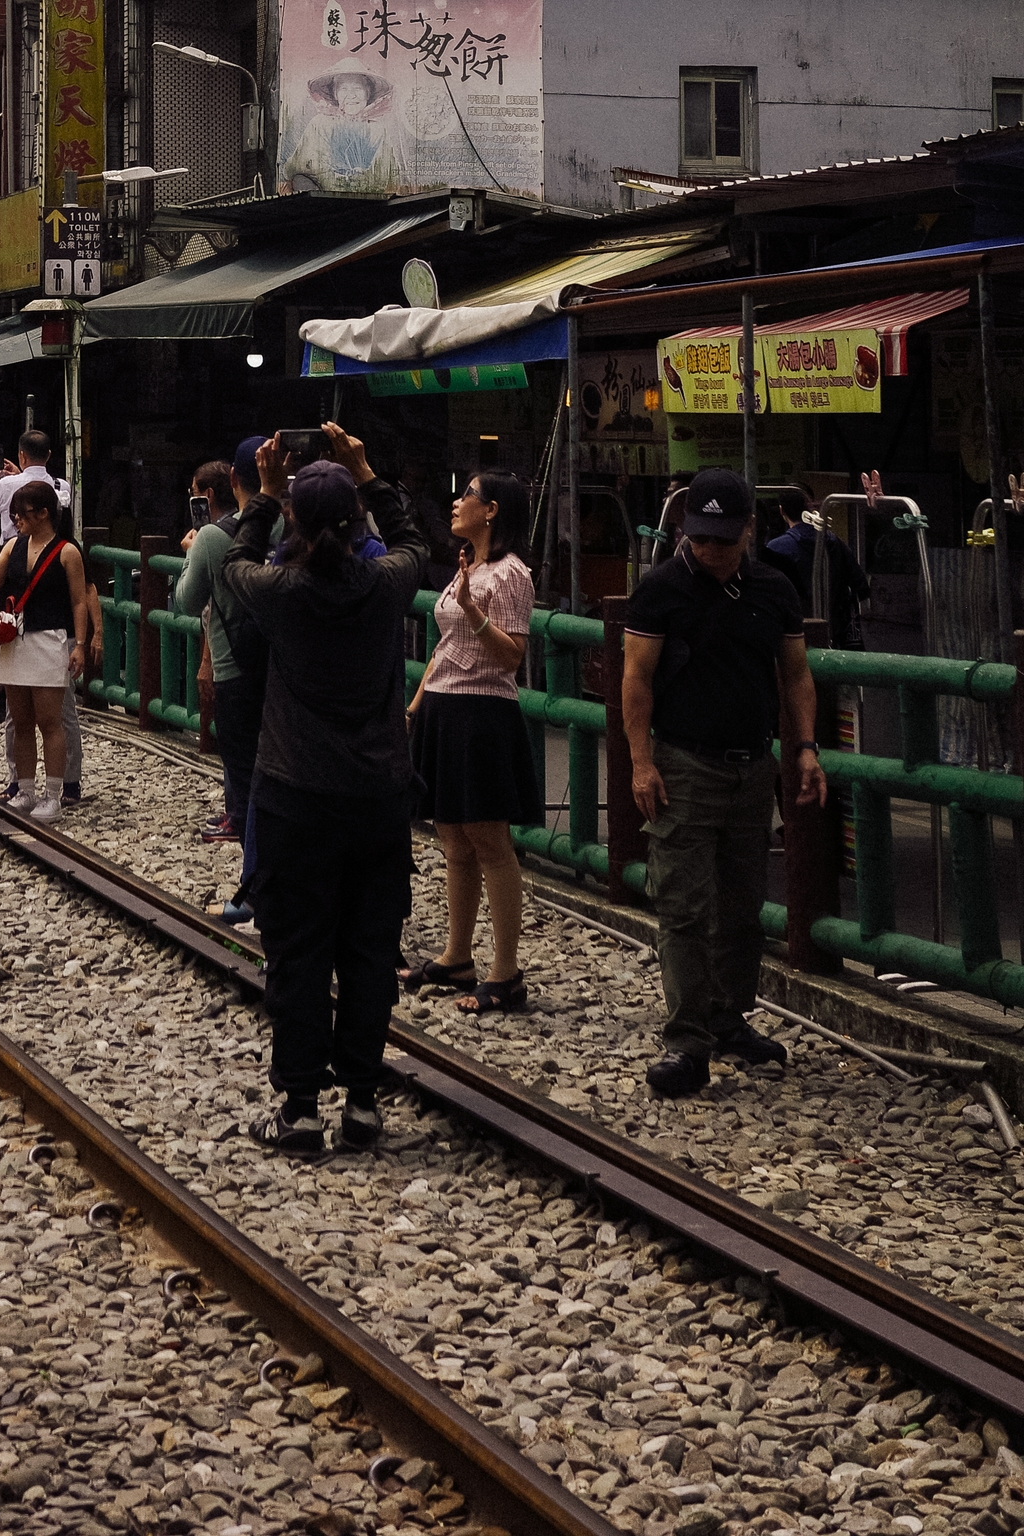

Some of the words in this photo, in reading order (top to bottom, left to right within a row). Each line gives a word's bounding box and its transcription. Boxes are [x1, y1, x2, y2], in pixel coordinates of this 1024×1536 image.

[407, 160, 439, 169] Specialty
[70, 212, 100, 222] 110M
[77, 250, 101, 259] 화장실
[686, 343, 731, 374] 雞翅包飯
[776, 337, 838, 372] 大腸包小腸
[768, 375, 783, 388] Small
[783, 375, 805, 390] Sausage
[805, 374, 812, 388] in
[812, 375, 829, 390] Large
[829, 374, 854, 390] Sausage
